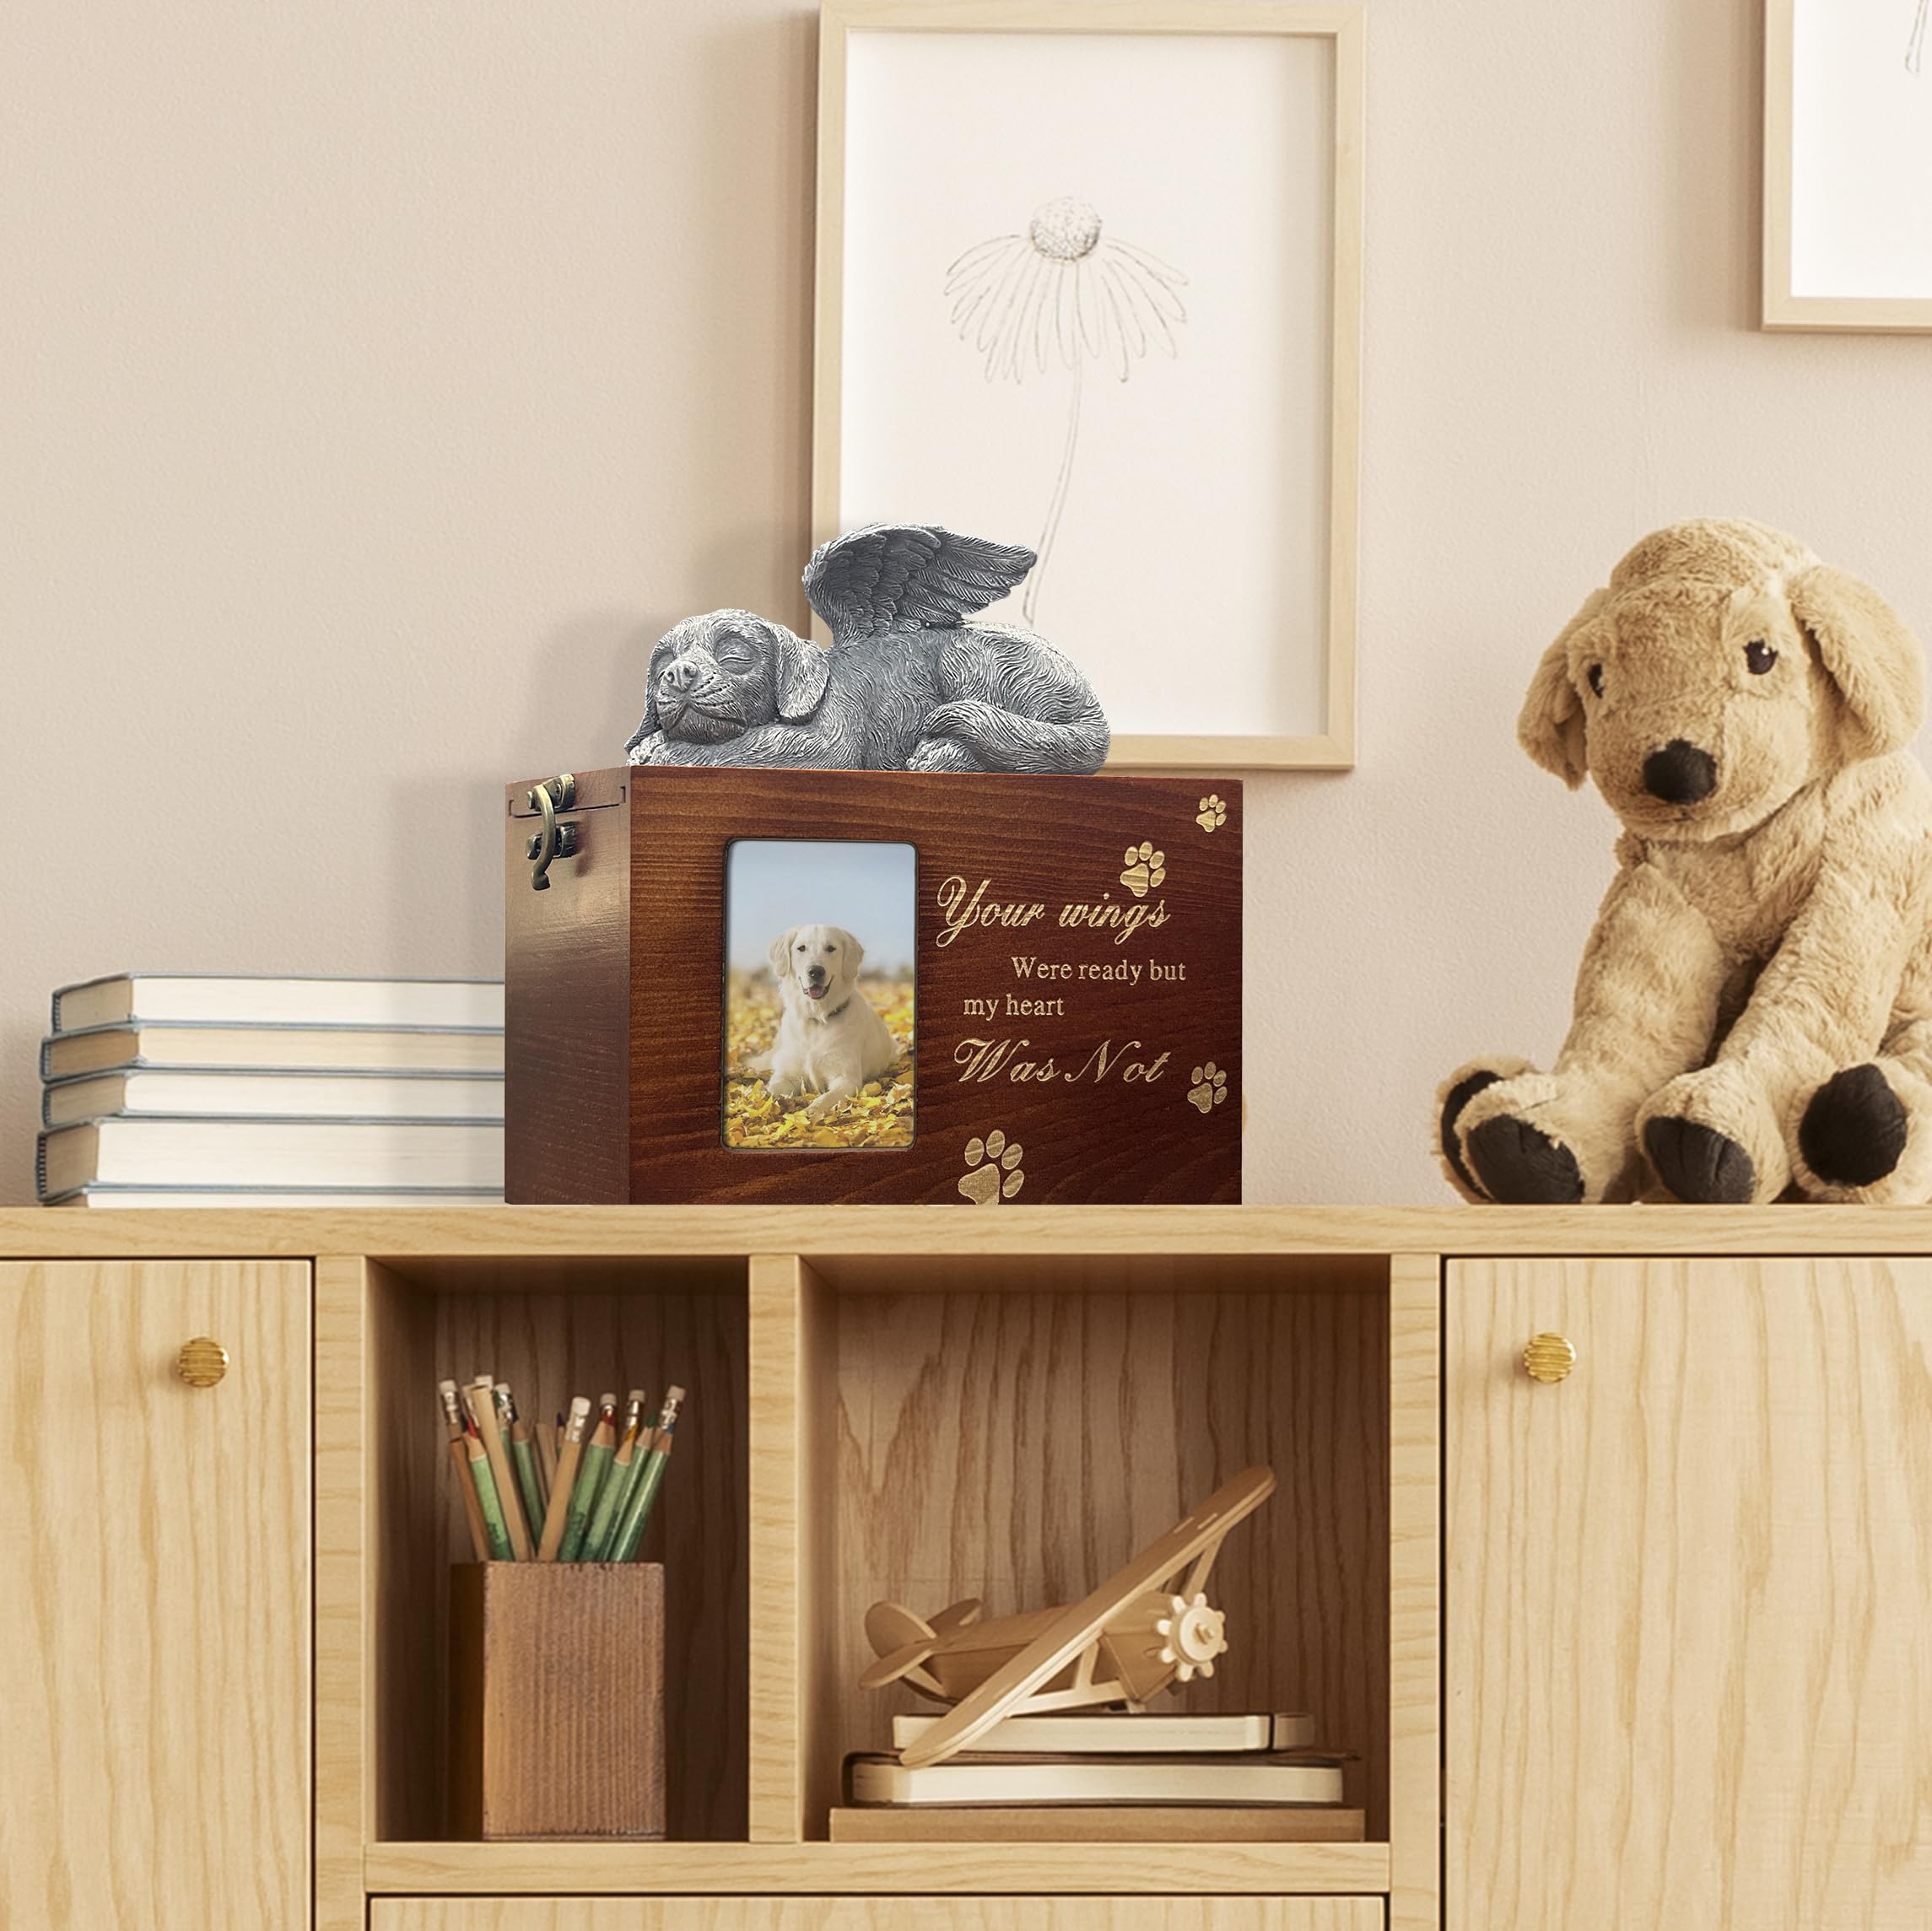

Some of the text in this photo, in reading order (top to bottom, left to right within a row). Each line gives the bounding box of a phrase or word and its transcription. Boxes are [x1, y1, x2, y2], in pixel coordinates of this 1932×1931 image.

[936, 875, 1171, 947] Your wings
[1012, 957, 1186, 985] Were ready but
[963, 993, 1065, 1021] my heart
[954, 1038, 1171, 1082] Was Not
